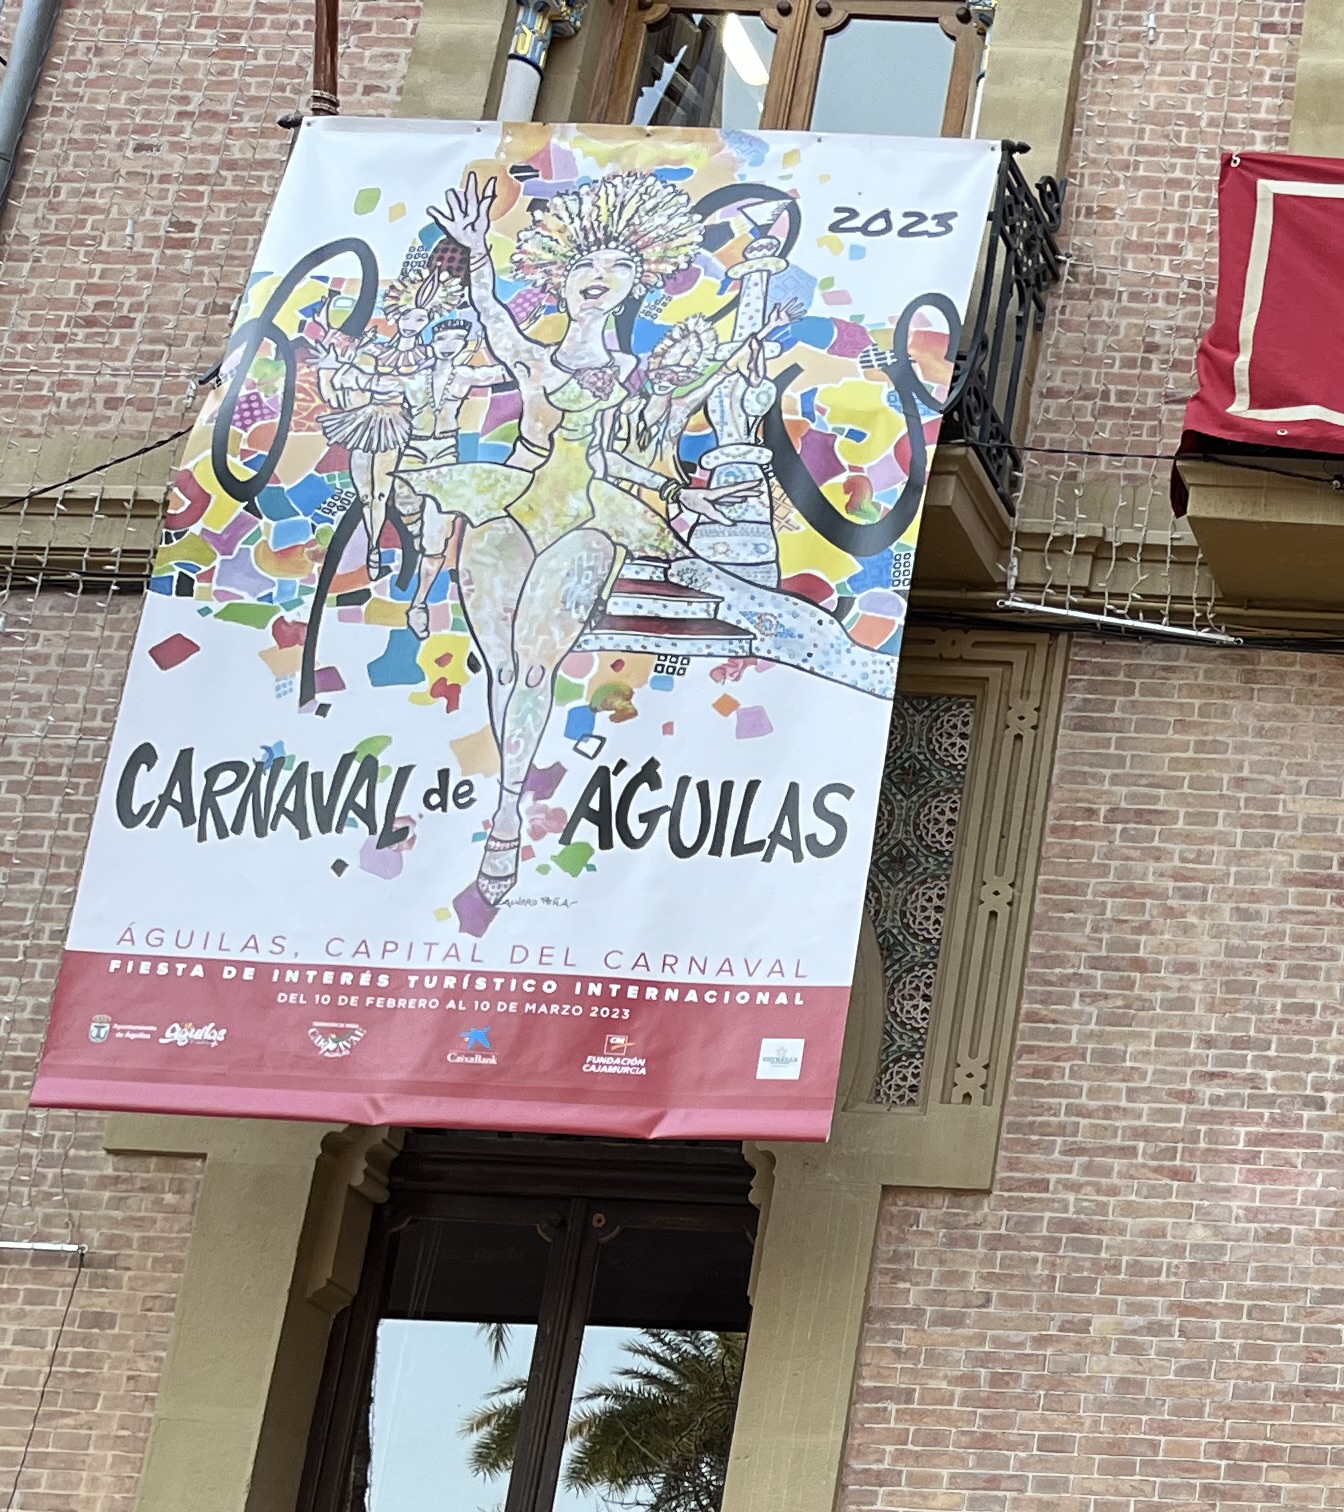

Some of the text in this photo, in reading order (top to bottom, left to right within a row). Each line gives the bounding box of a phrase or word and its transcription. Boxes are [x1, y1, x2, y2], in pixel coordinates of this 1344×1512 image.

[828, 206, 958, 238] 2023
[116, 742, 855, 863] CARNAVAL de ÁGUILAS
[116, 922, 807, 978] ÁGUILAS, CAPITAL DEL CARNAVAL
[109, 959, 805, 1006] FIESTA DE INTERÉS TURÍSTICO INTERNACIONAL
[277, 992, 631, 1020] DEL 10 DE FEBRERO AL 10 DE MARZO 2023
[447, 1052, 497, 1065] CaixaBank
[582, 1064, 647, 1076] CAJAMURCIA
[586, 1055, 646, 1067] FUNDACIÓN
